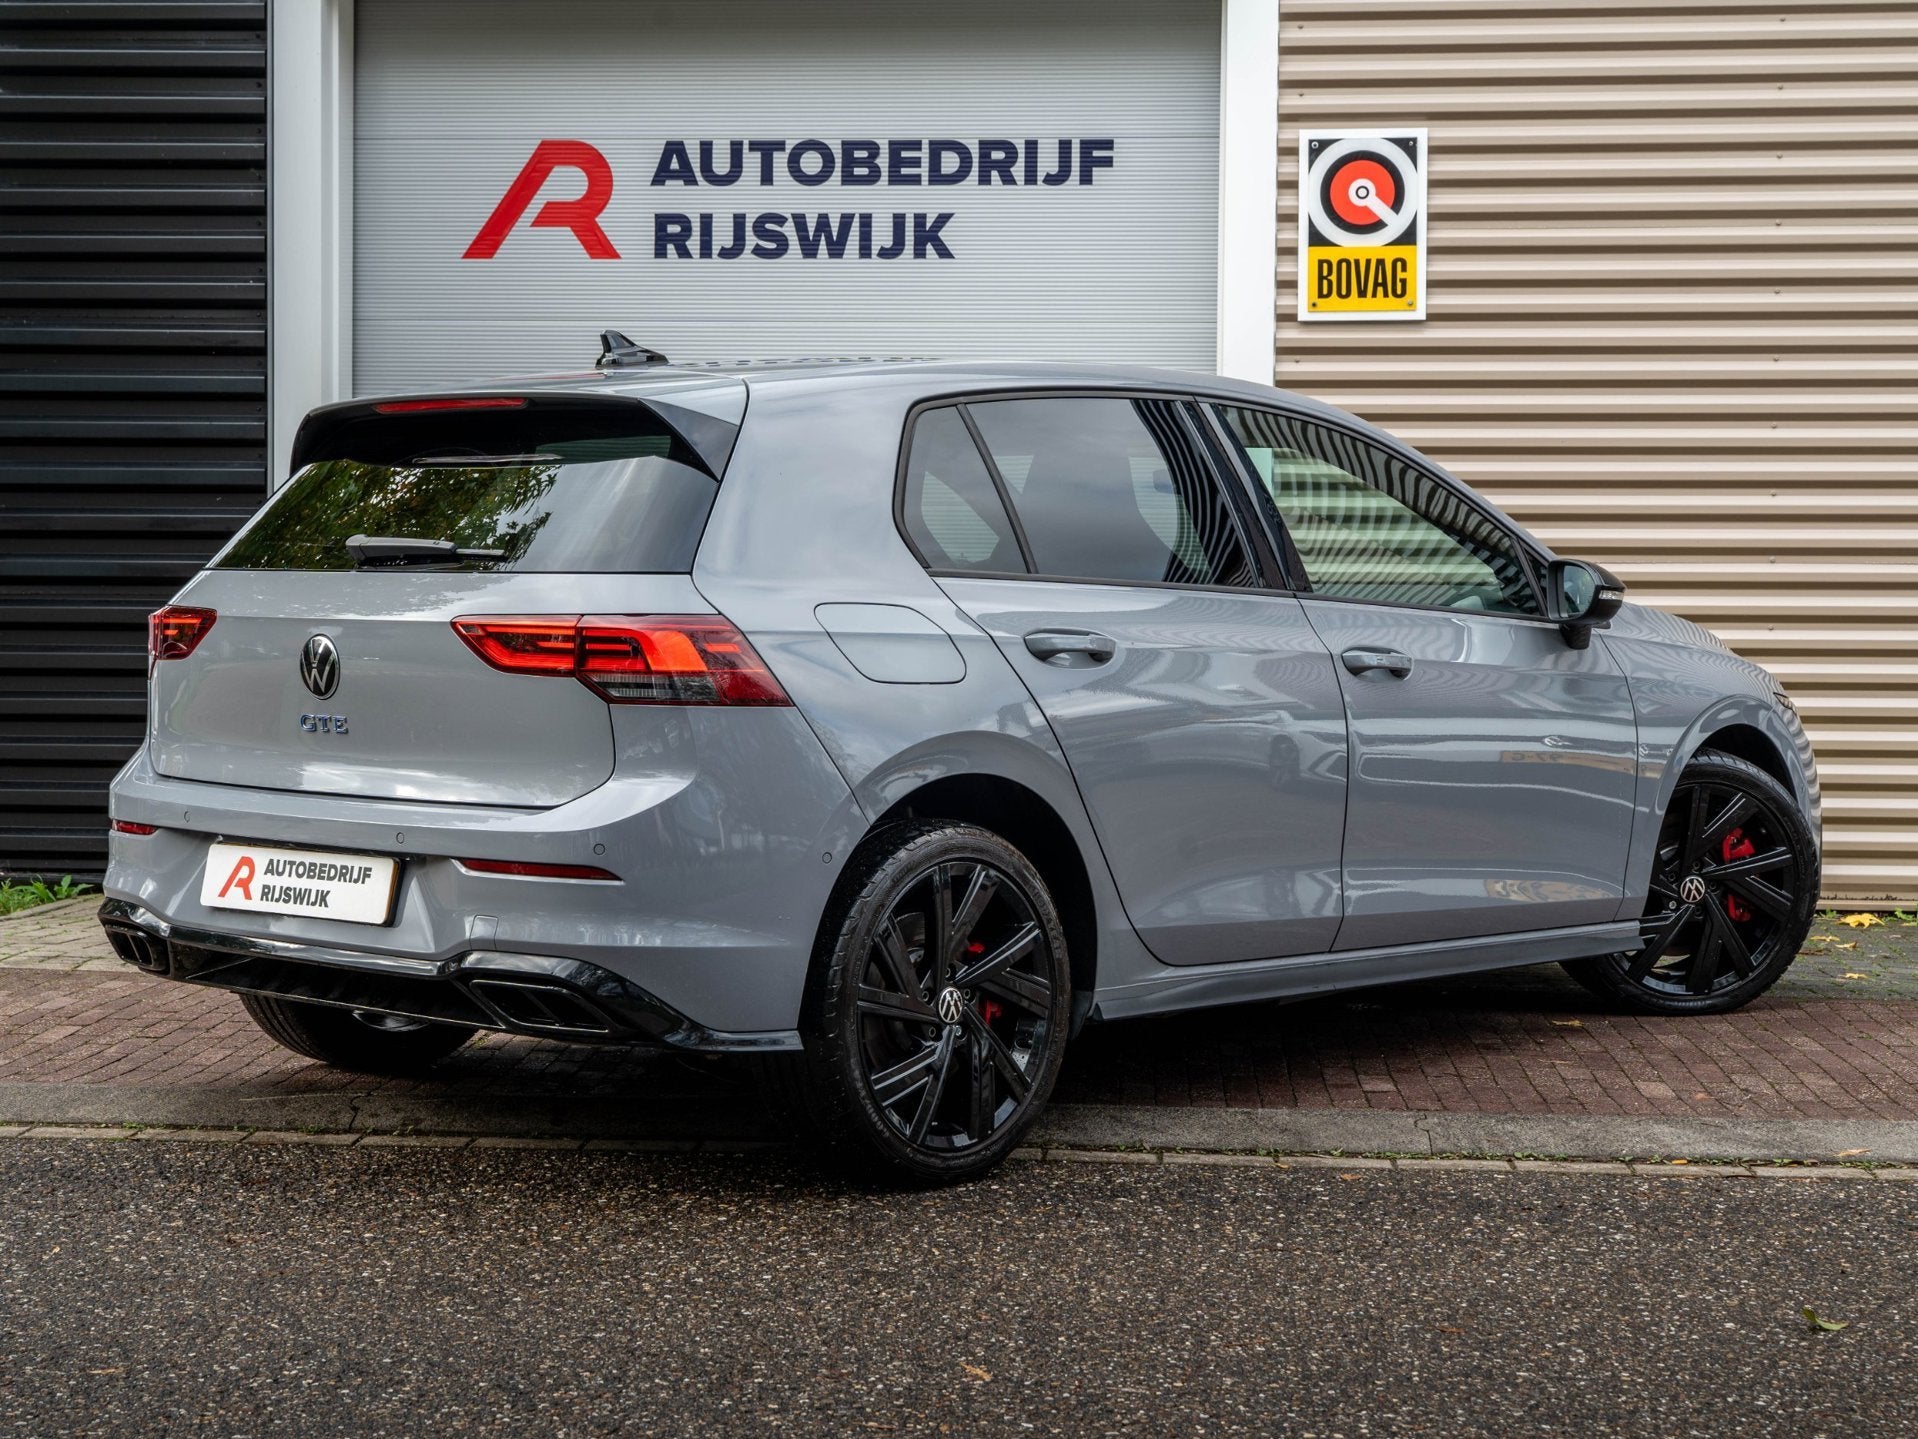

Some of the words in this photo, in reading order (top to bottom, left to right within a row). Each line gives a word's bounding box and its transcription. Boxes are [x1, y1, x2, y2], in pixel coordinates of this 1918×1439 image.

[651, 139, 1114, 187] AUTOBEDRIJF
[653, 212, 956, 259] RIJSWIJK
[1317, 257, 1408, 299] BOVAG
[300, 714, 349, 734] GTE
[264, 858, 372, 884] AUTOBEDRIJF
[260, 884, 331, 908] RIJSWIJK
